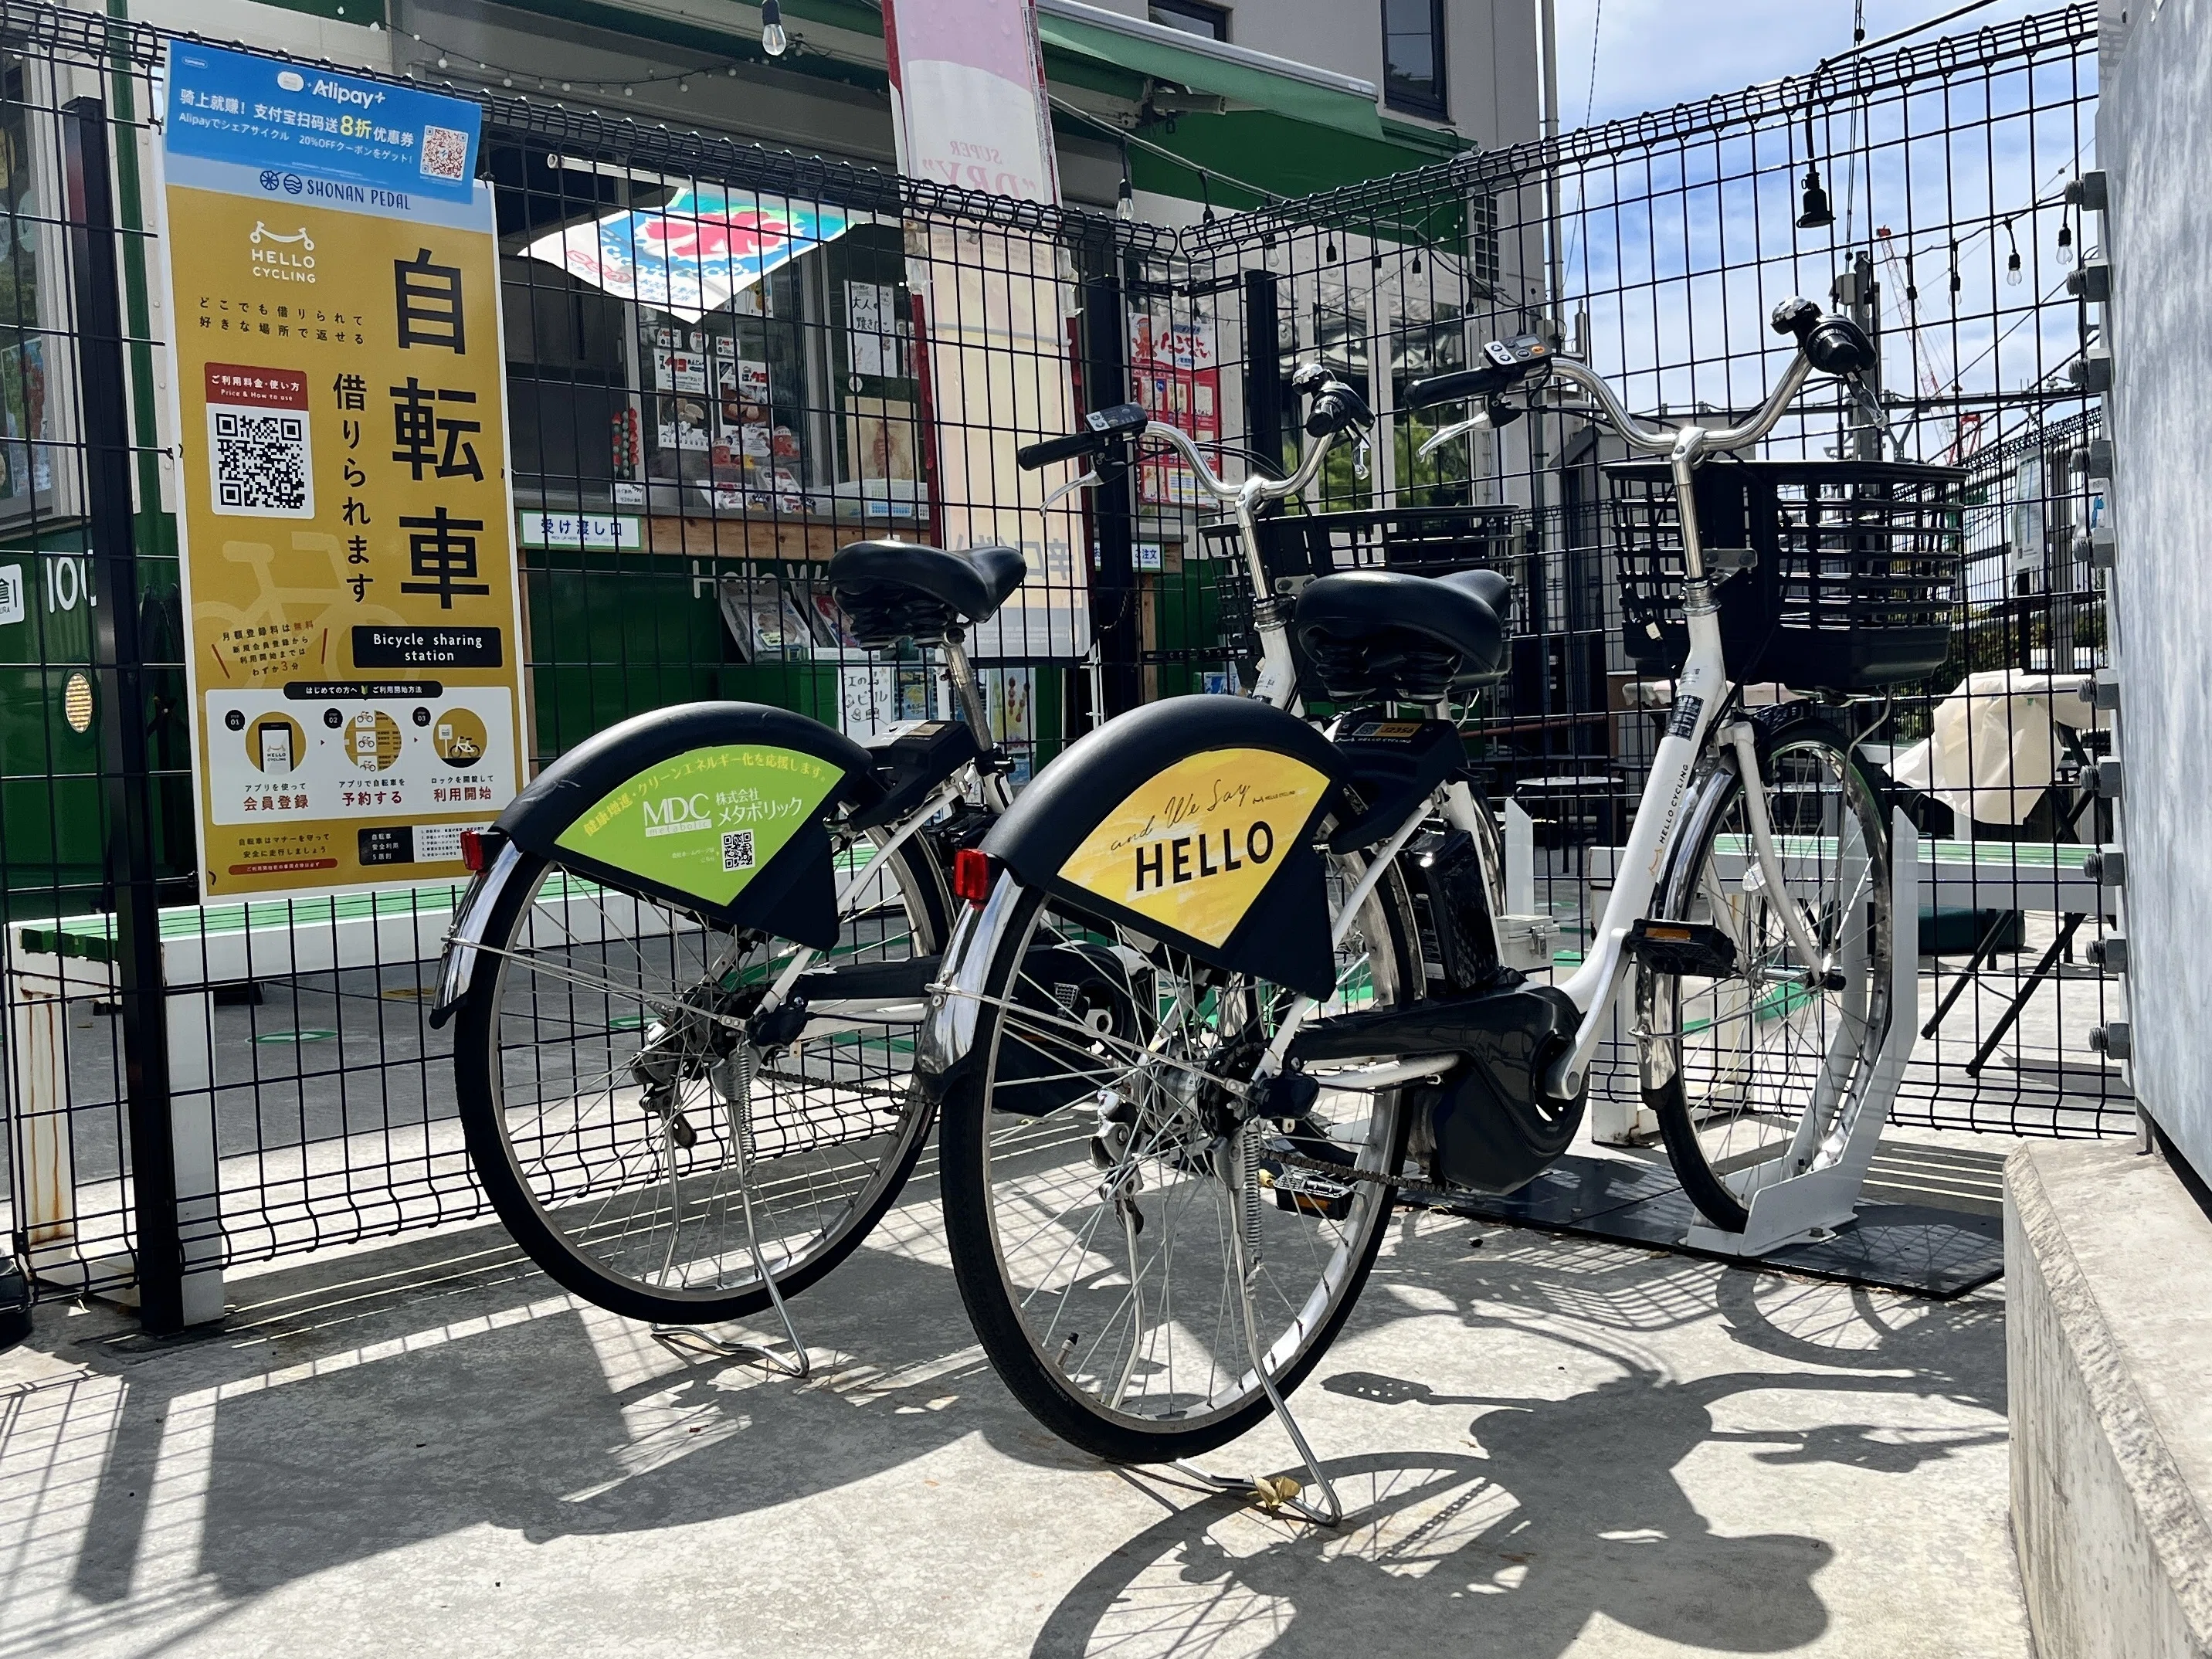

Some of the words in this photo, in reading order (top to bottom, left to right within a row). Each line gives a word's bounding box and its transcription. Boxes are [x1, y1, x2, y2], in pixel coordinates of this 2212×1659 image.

[312, 80, 385, 109] Alipay+
[178, 112, 290, 141] Alipayでシェアサイクル
[307, 179, 365, 203] SHONAN
[371, 188, 412, 209] PEDAL
[251, 248, 315, 269] HELLO
[253, 266, 316, 283] CYCLING
[200, 297, 363, 326] どこでも借りられて
[199, 315, 364, 345] 好きな場所で返せる
[211, 374, 300, 392] ご利用料金・使い方
[221, 388, 240, 398] Price
[250, 391, 267, 399] How
[390, 247, 490, 609] 自転車
[332, 373, 374, 602] 借りられます
[541, 518, 623, 536] 受け渡し口
[373, 634, 424, 648] Bicycle
[433, 635, 483, 649] sharing
[405, 650, 455, 662] station
[253, 661, 299, 677] わずか3分
[305, 685, 358, 695] はじめての方へ
[372, 685, 422, 694] ご利用開始方法
[245, 782, 307, 792] アプリを使って
[338, 778, 405, 788] アプリで自転車を
[431, 775, 494, 785] ロックを開錠して
[342, 789, 403, 806] 予約する
[434, 786, 492, 802] 利用開始
[716, 787, 760, 806] 株式会社
[243, 795, 309, 812] 会員登録
[643, 793, 711, 826] MDC
[717, 797, 803, 828] メタボリック
[1659, 809, 1674, 844] HELLO
[1671, 764, 1689, 807] CYCLING
[1111, 815, 1155, 851] and
[1164, 792, 1199, 829] We
[1207, 779, 1251, 812] Say
[647, 819, 709, 836] metabolic
[239, 833, 330, 846] 自転車はマナーを守って
[243, 846, 327, 858] 安全に走行しましょう
[1135, 820, 1274, 892] HELLO
